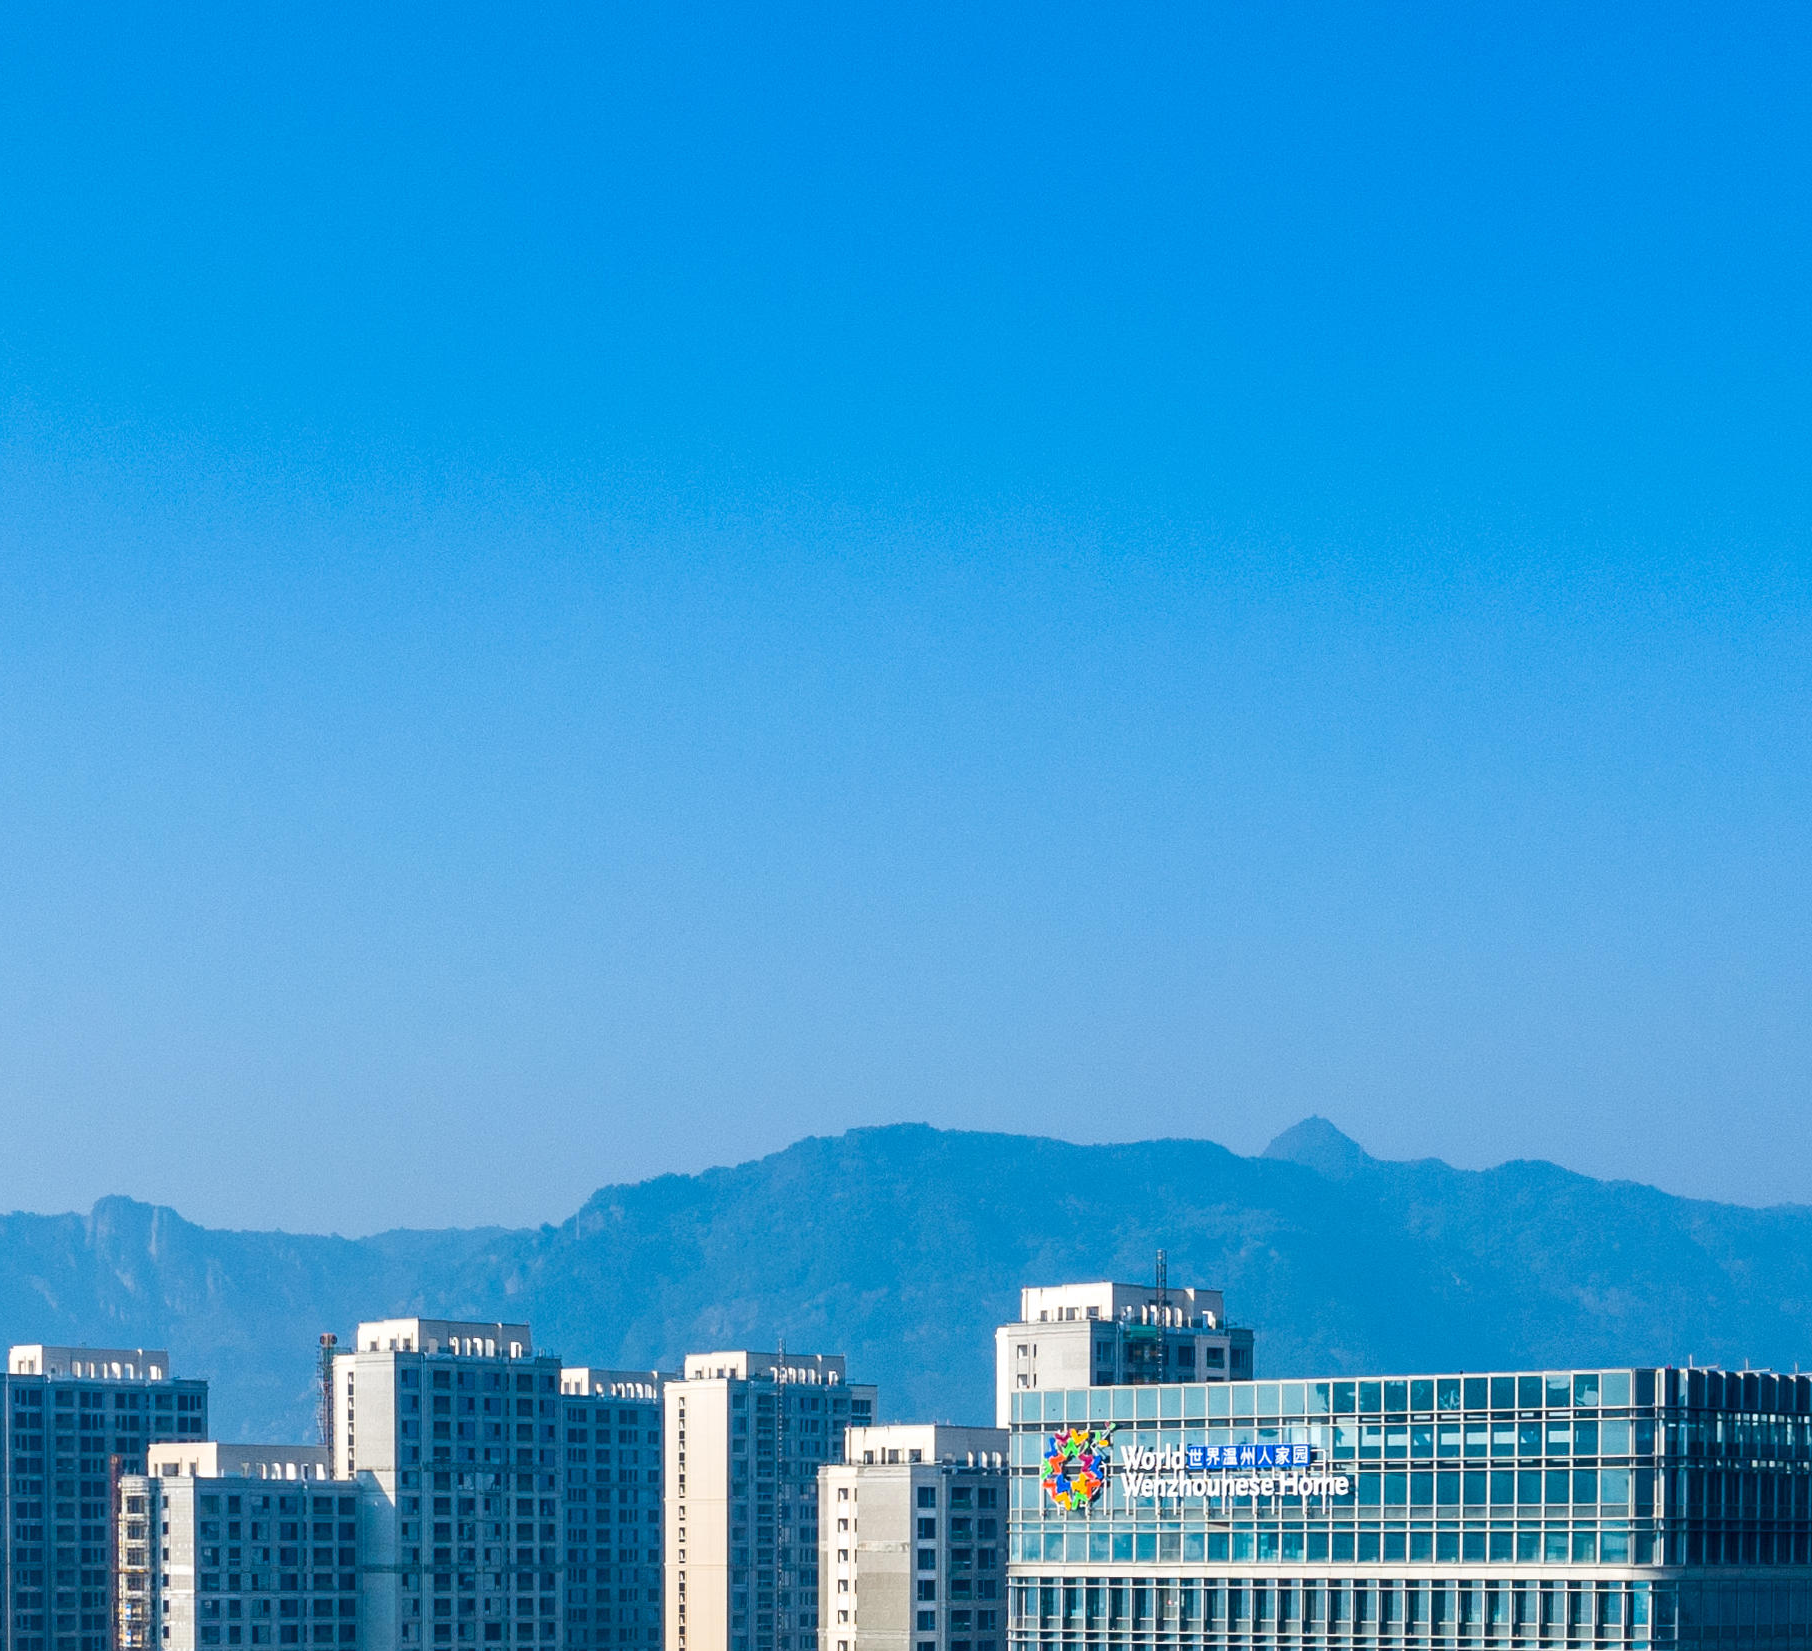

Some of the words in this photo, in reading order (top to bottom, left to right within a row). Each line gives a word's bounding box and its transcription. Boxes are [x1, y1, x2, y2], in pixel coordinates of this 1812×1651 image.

[1121, 1444, 1185, 1471] World
[1188, 1445, 1310, 1466] 世界温州人家园
[1121, 1473, 1274, 1498] Wenzhounese
[1279, 1474, 1349, 1497] Home
